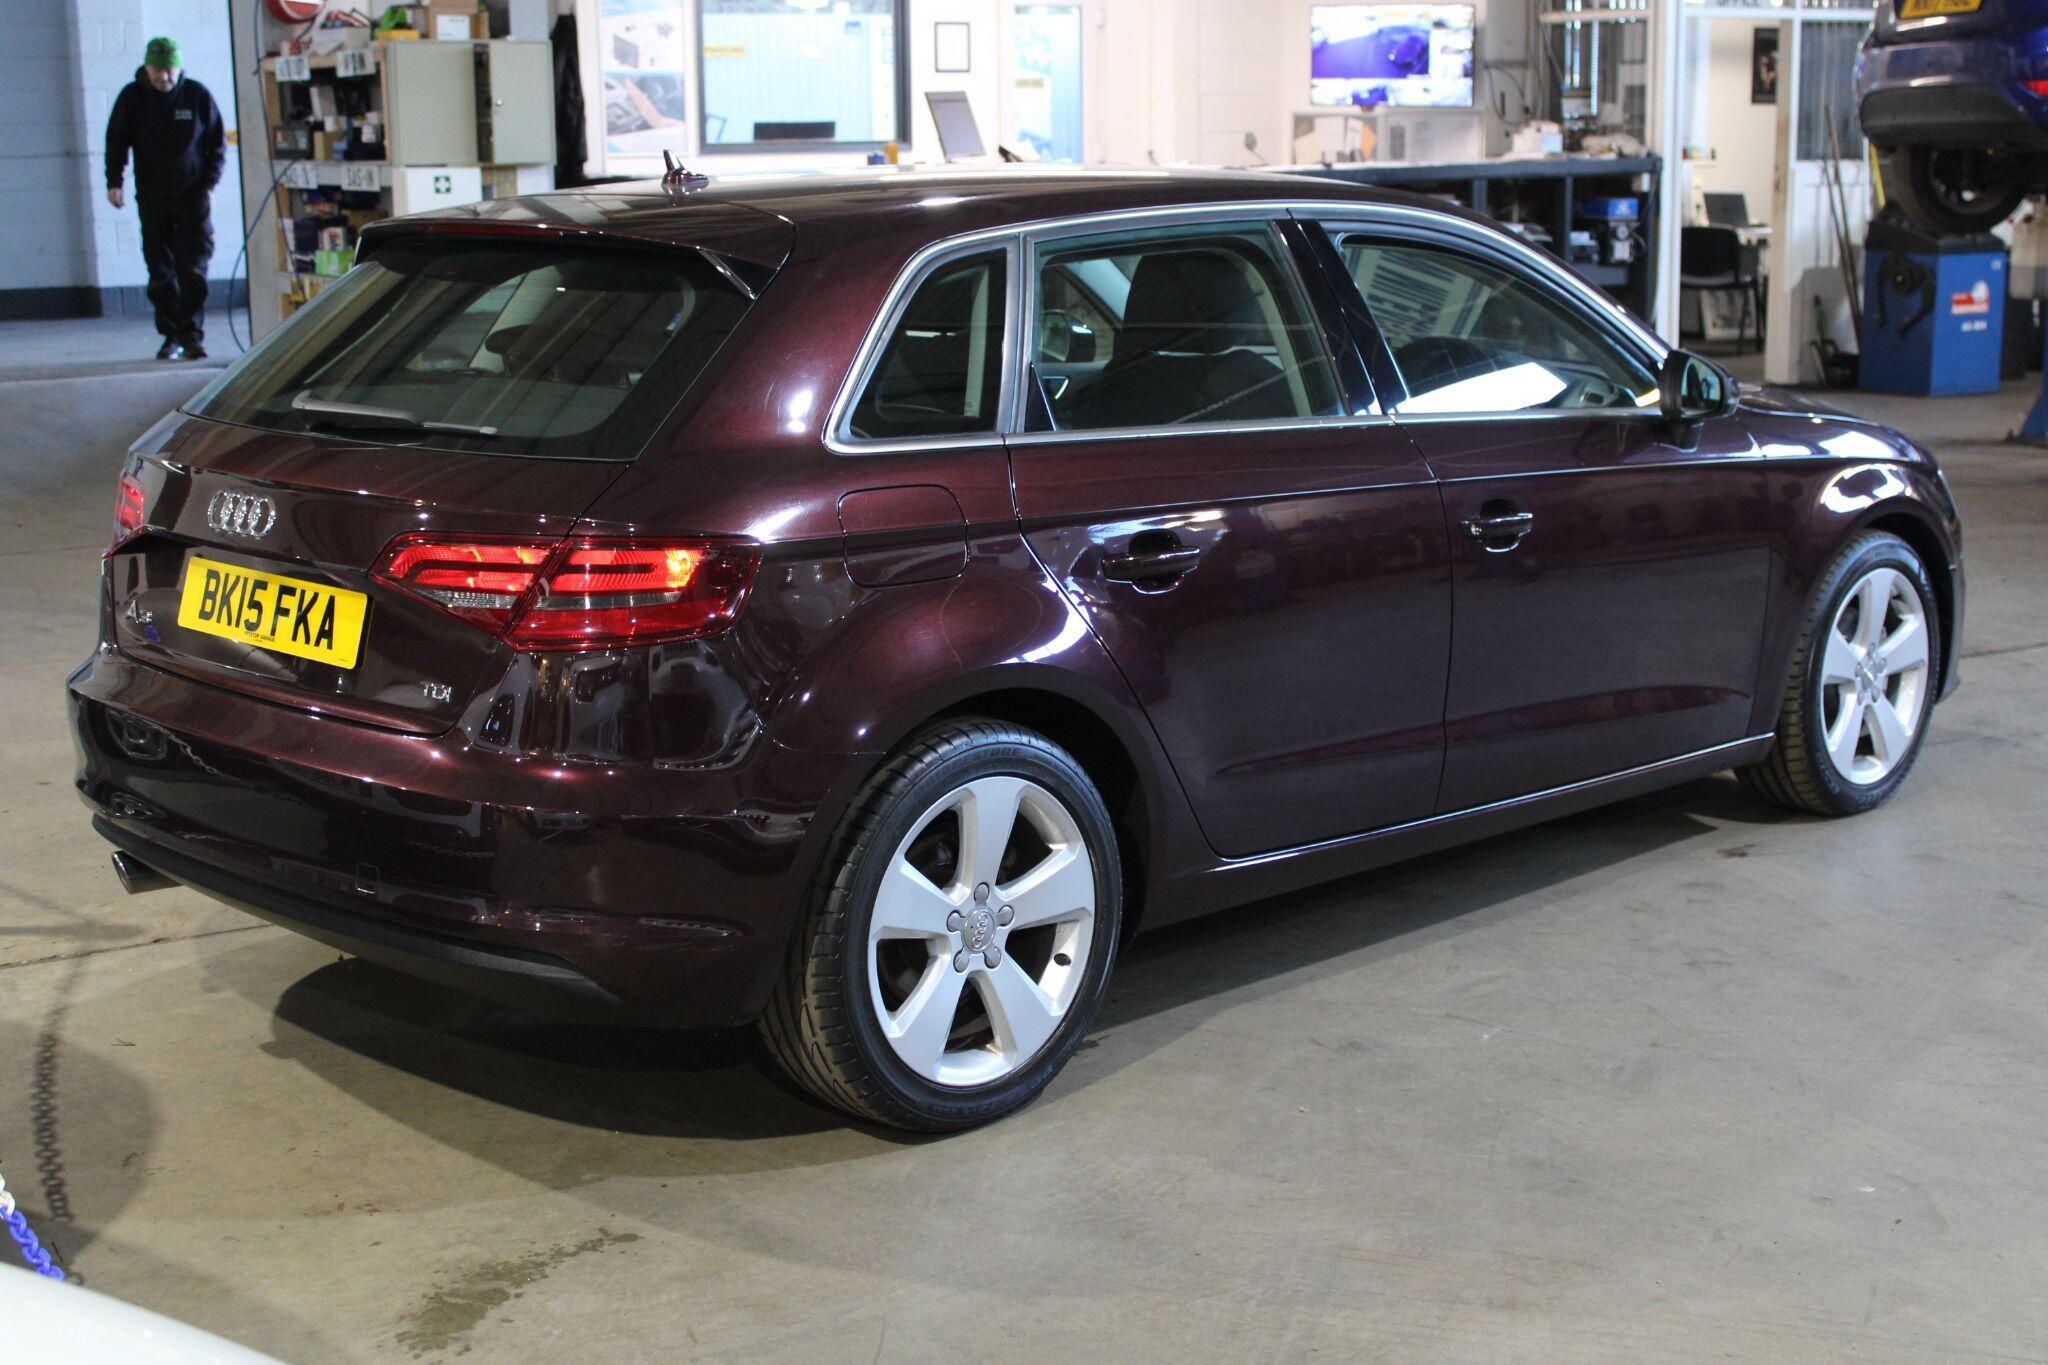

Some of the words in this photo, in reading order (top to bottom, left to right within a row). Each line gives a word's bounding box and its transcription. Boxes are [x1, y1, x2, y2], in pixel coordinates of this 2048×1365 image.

[198, 569, 268, 632] BK15
[270, 584, 336, 651] FKA
[420, 681, 452, 703] TDI
